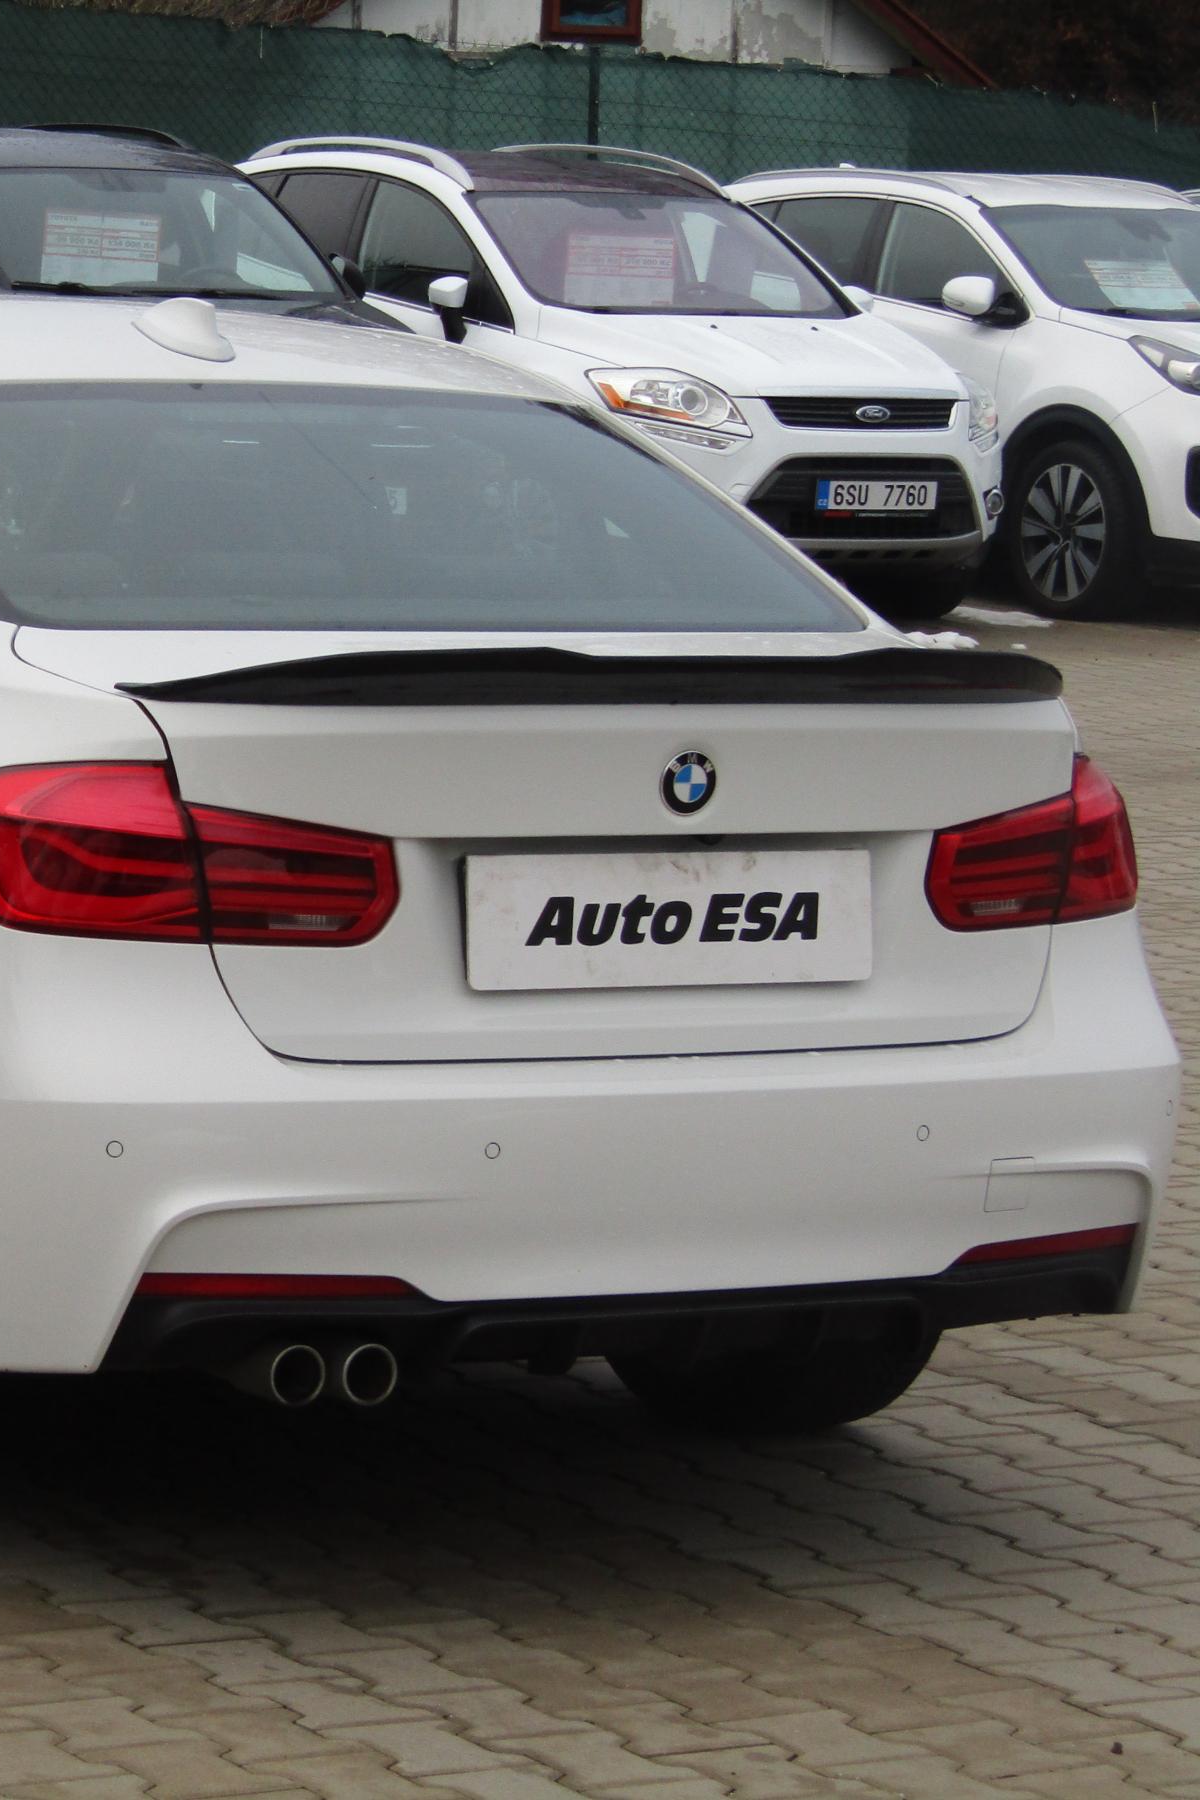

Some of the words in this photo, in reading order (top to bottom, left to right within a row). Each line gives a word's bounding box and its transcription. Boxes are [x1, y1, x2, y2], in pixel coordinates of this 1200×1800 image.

[833, 484, 869, 506] 6SU
[883, 484, 928, 506] 7760
[669, 752, 714, 773] BMW
[525, 894, 692, 947] Auto
[699, 892, 819, 943] ESA
